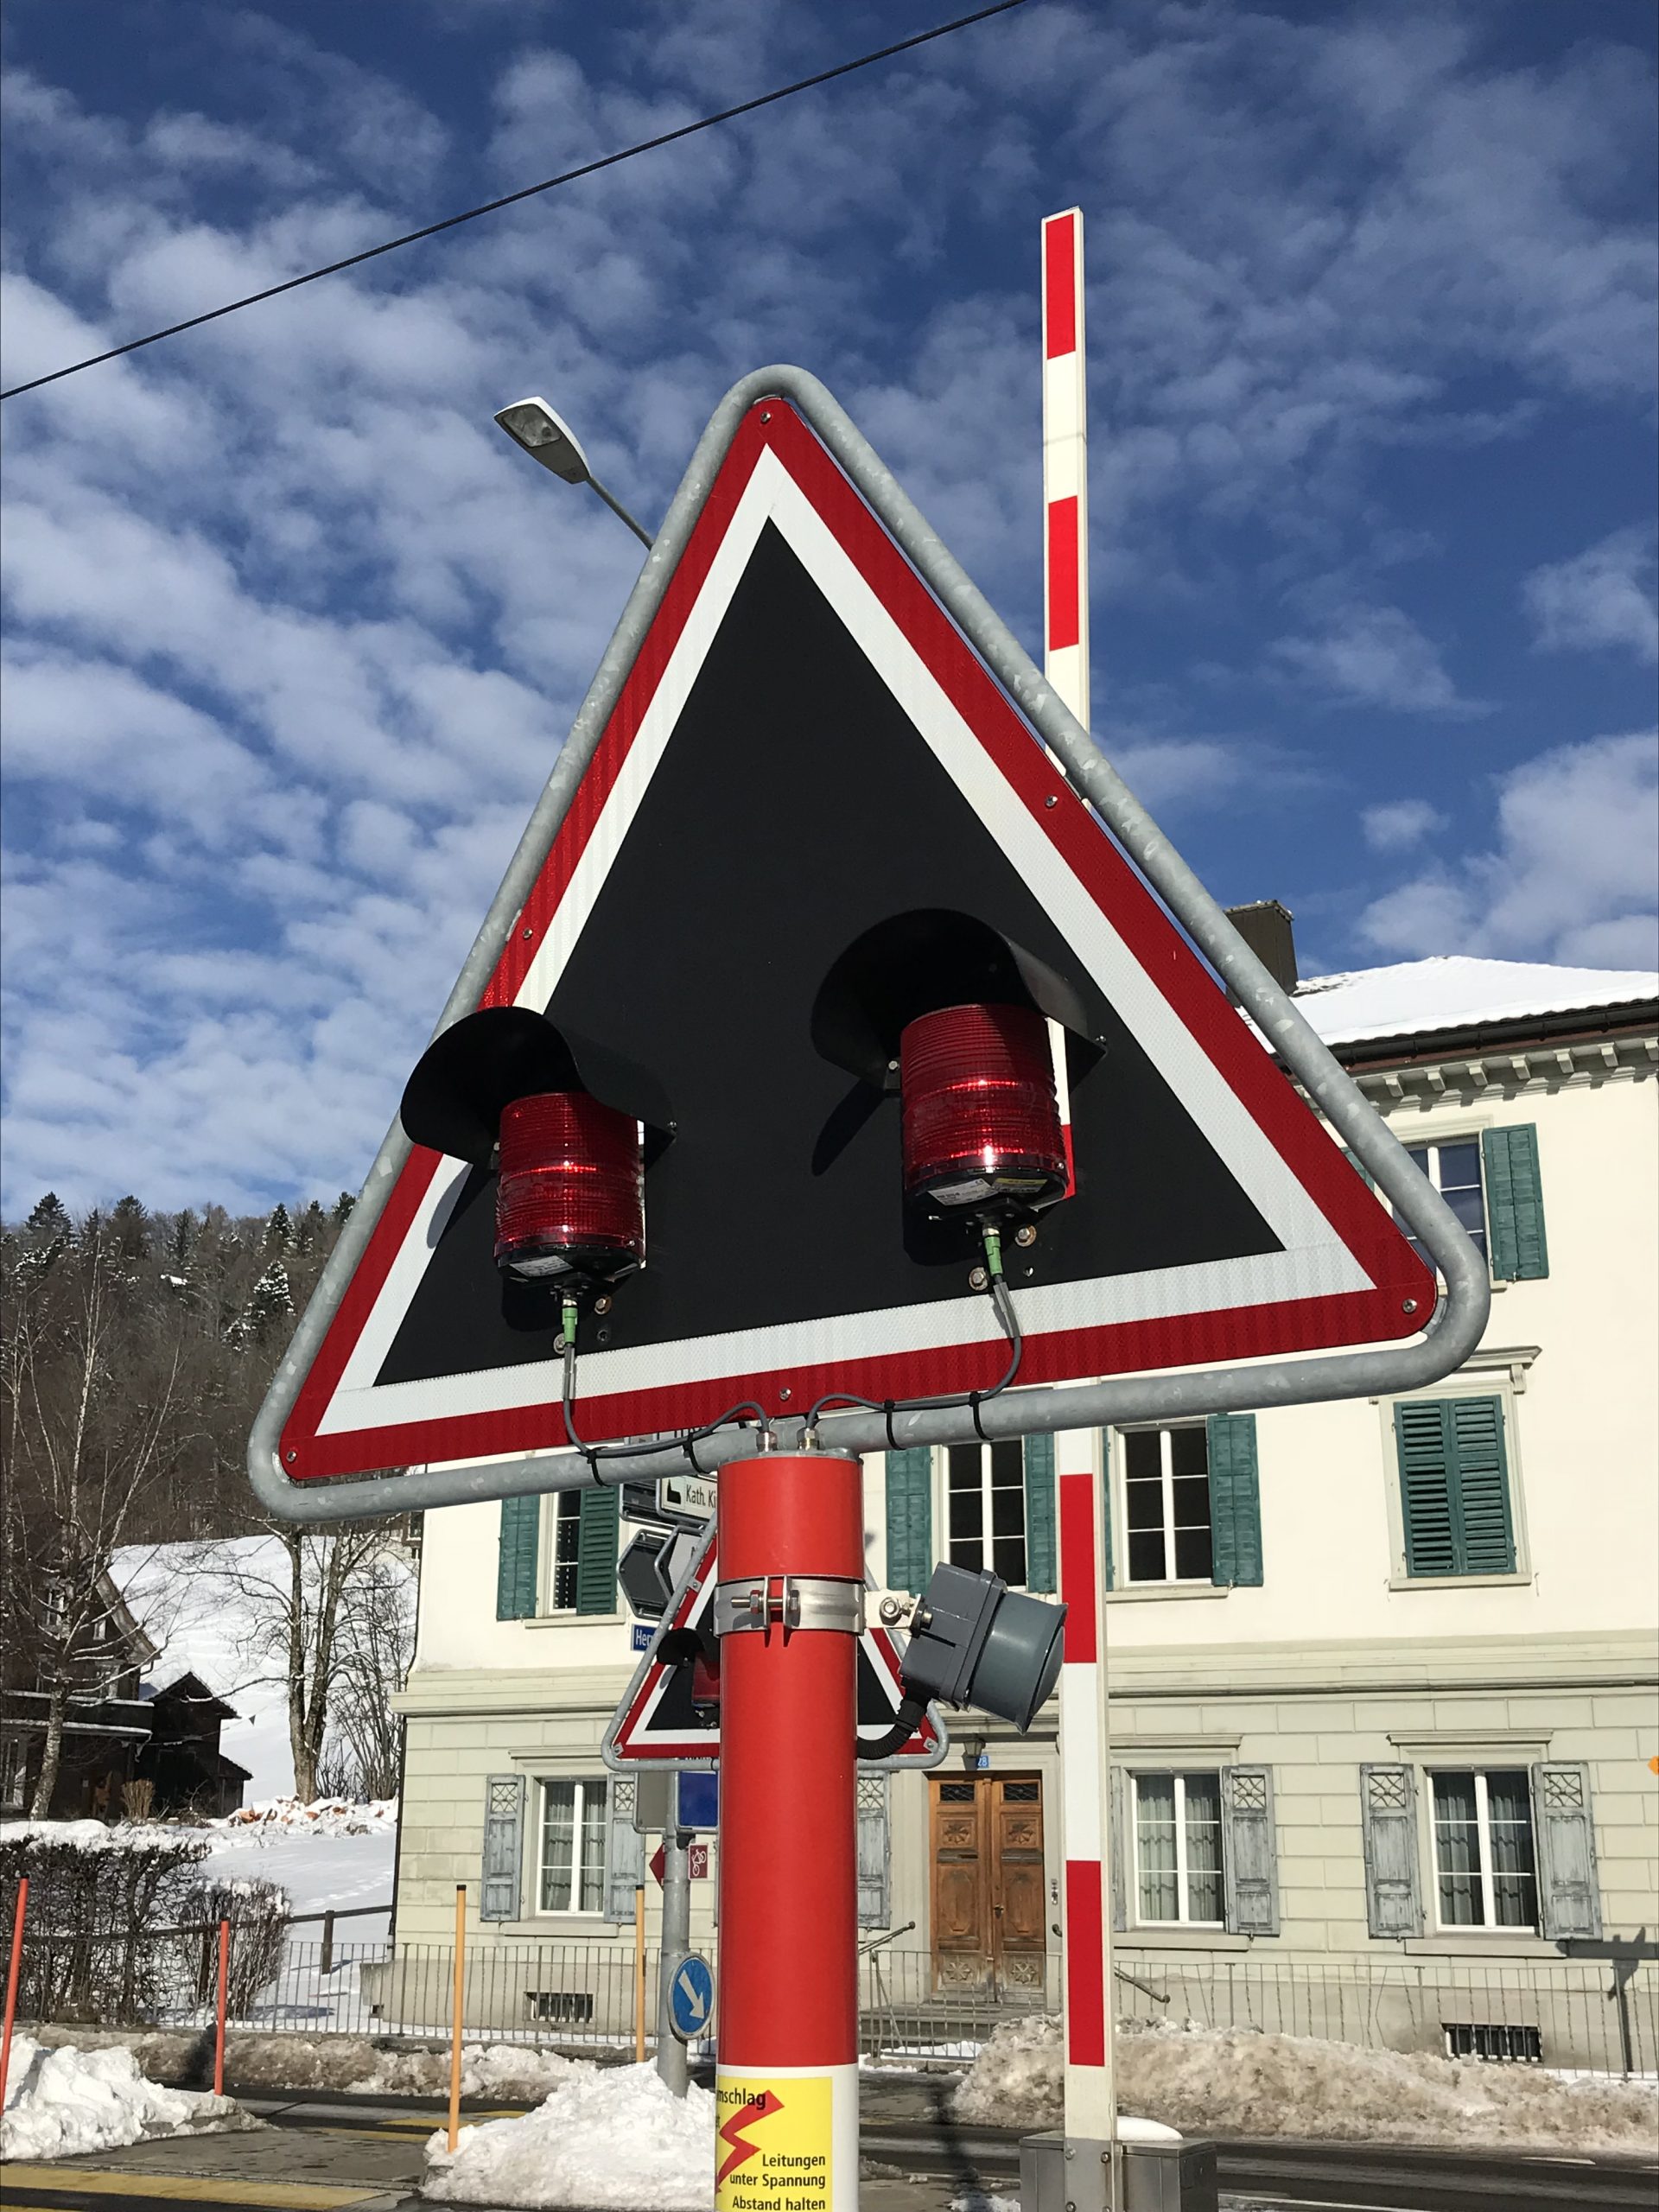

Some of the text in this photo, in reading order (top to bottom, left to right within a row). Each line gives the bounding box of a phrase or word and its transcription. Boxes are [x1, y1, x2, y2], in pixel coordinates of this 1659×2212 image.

[686, 1484, 706, 1506] Kath.
[762, 2153, 826, 2170] Leitungen
[730, 2173, 826, 2190] unter Spannung
[733, 2196, 826, 2210] Abstand halten
